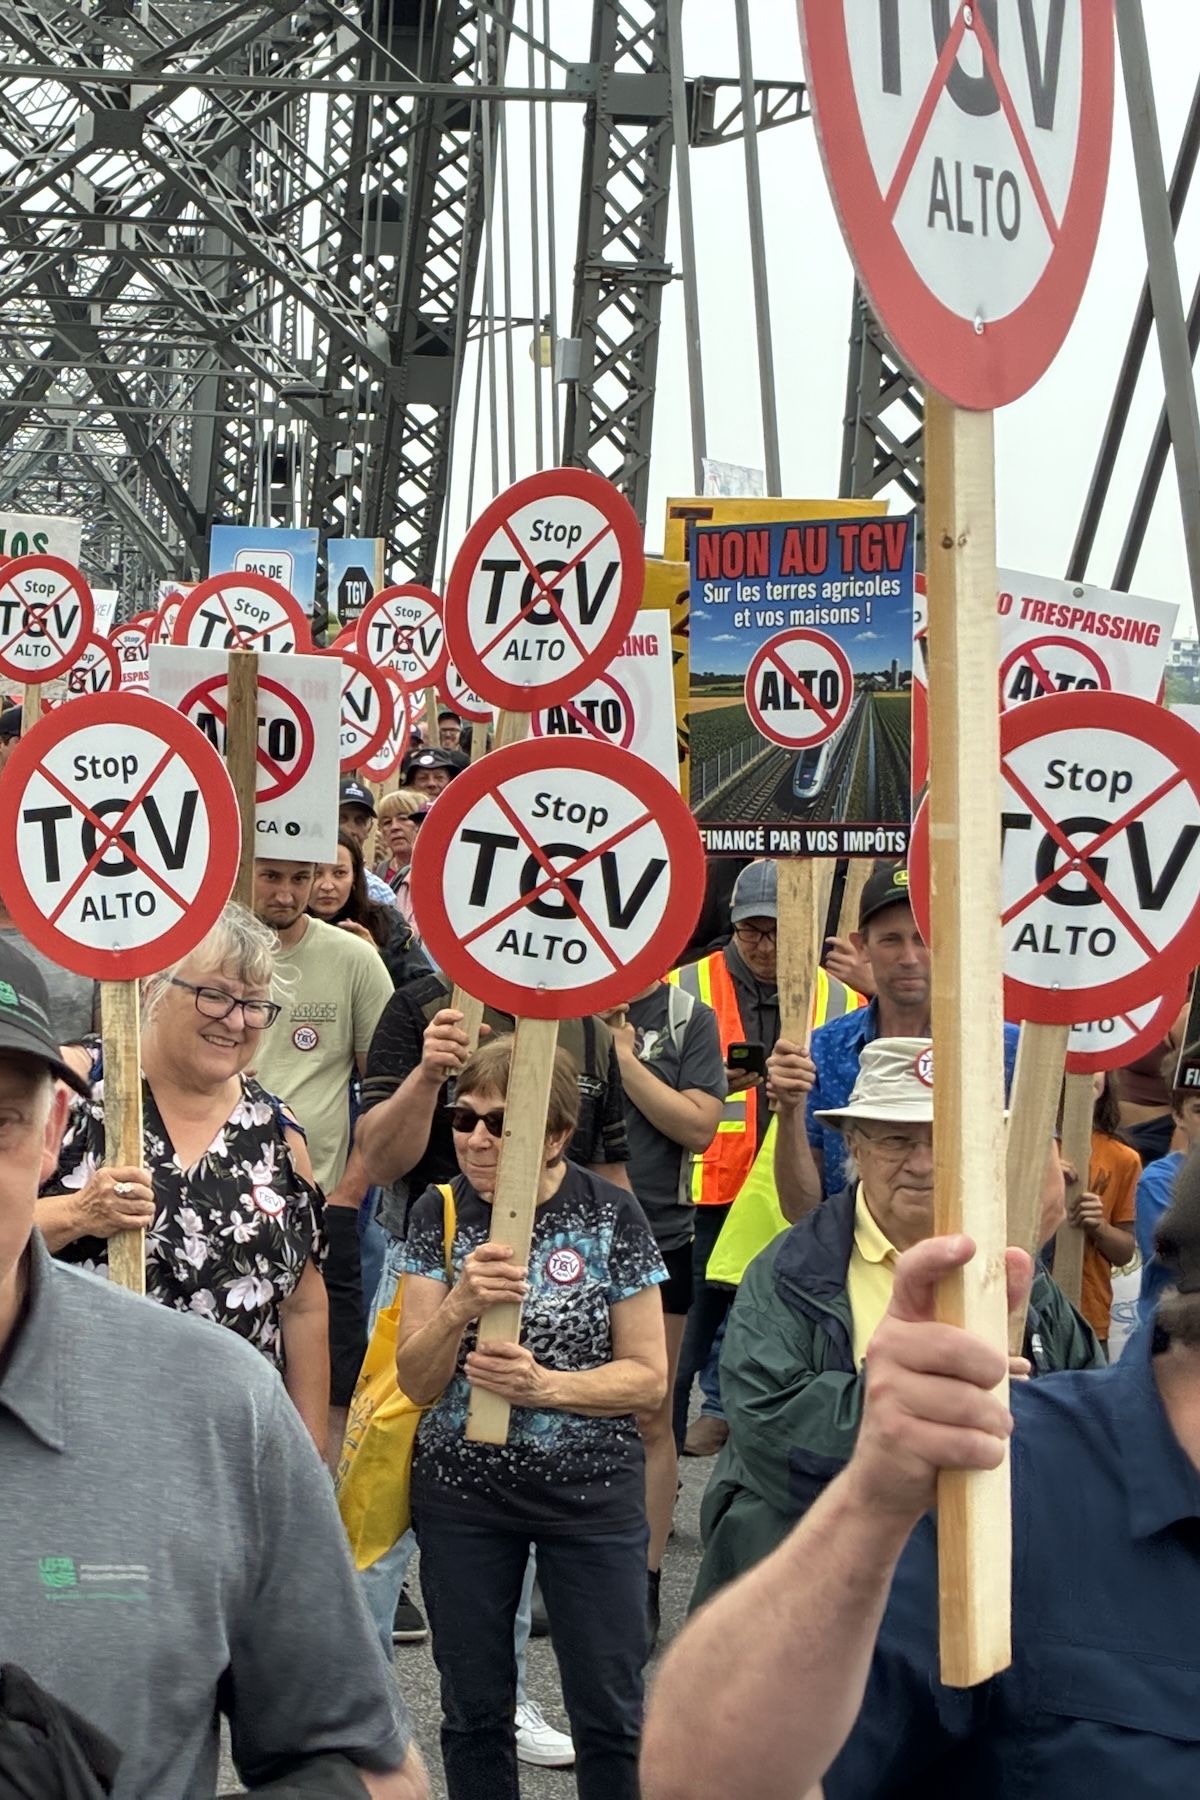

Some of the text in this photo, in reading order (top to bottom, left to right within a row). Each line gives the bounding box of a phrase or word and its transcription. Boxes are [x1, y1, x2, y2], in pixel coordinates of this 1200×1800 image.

[927, 156, 1021, 242] ALTO
[529, 519, 583, 549] Stop
[695, 527, 772, 581] NON
[779, 524, 828, 578] AU
[838, 521, 909, 574] TGV
[268, 564, 283, 579] DE
[24, 580, 56, 597] Stop
[345, 581, 367, 605] TGV
[480, 559, 621, 626] TGV
[703, 577, 901, 604] Sur les terres agricoles
[234, 598, 271, 624] Stop
[394, 606, 422, 622] Stop
[734, 609, 752, 628] et
[756, 610, 785, 628] vos
[789, 606, 860, 627] maisons
[997, 592, 1161, 648] O TRESPASSING
[14, 643, 51, 658] ALTO
[371, 622, 442, 657] TGV
[503, 638, 566, 662] ALTO
[81, 653, 95, 664] op
[68, 667, 111, 694] GV
[759, 669, 840, 712] ALTO
[547, 699, 622, 735] ALTO
[196, 712, 297, 762] AO
[73, 753, 139, 785] Stop
[1044, 758, 1134, 801] Stop
[531, 792, 609, 835] Stop
[23, 789, 200, 884] TGV
[699, 826, 907, 853] FINANCÉ PAR VOS IMPÔTS
[460, 828, 668, 931] TGV
[80, 890, 157, 923] ALTO
[496, 928, 588, 965] ALTO
[1012, 922, 1117, 958] ALTO
